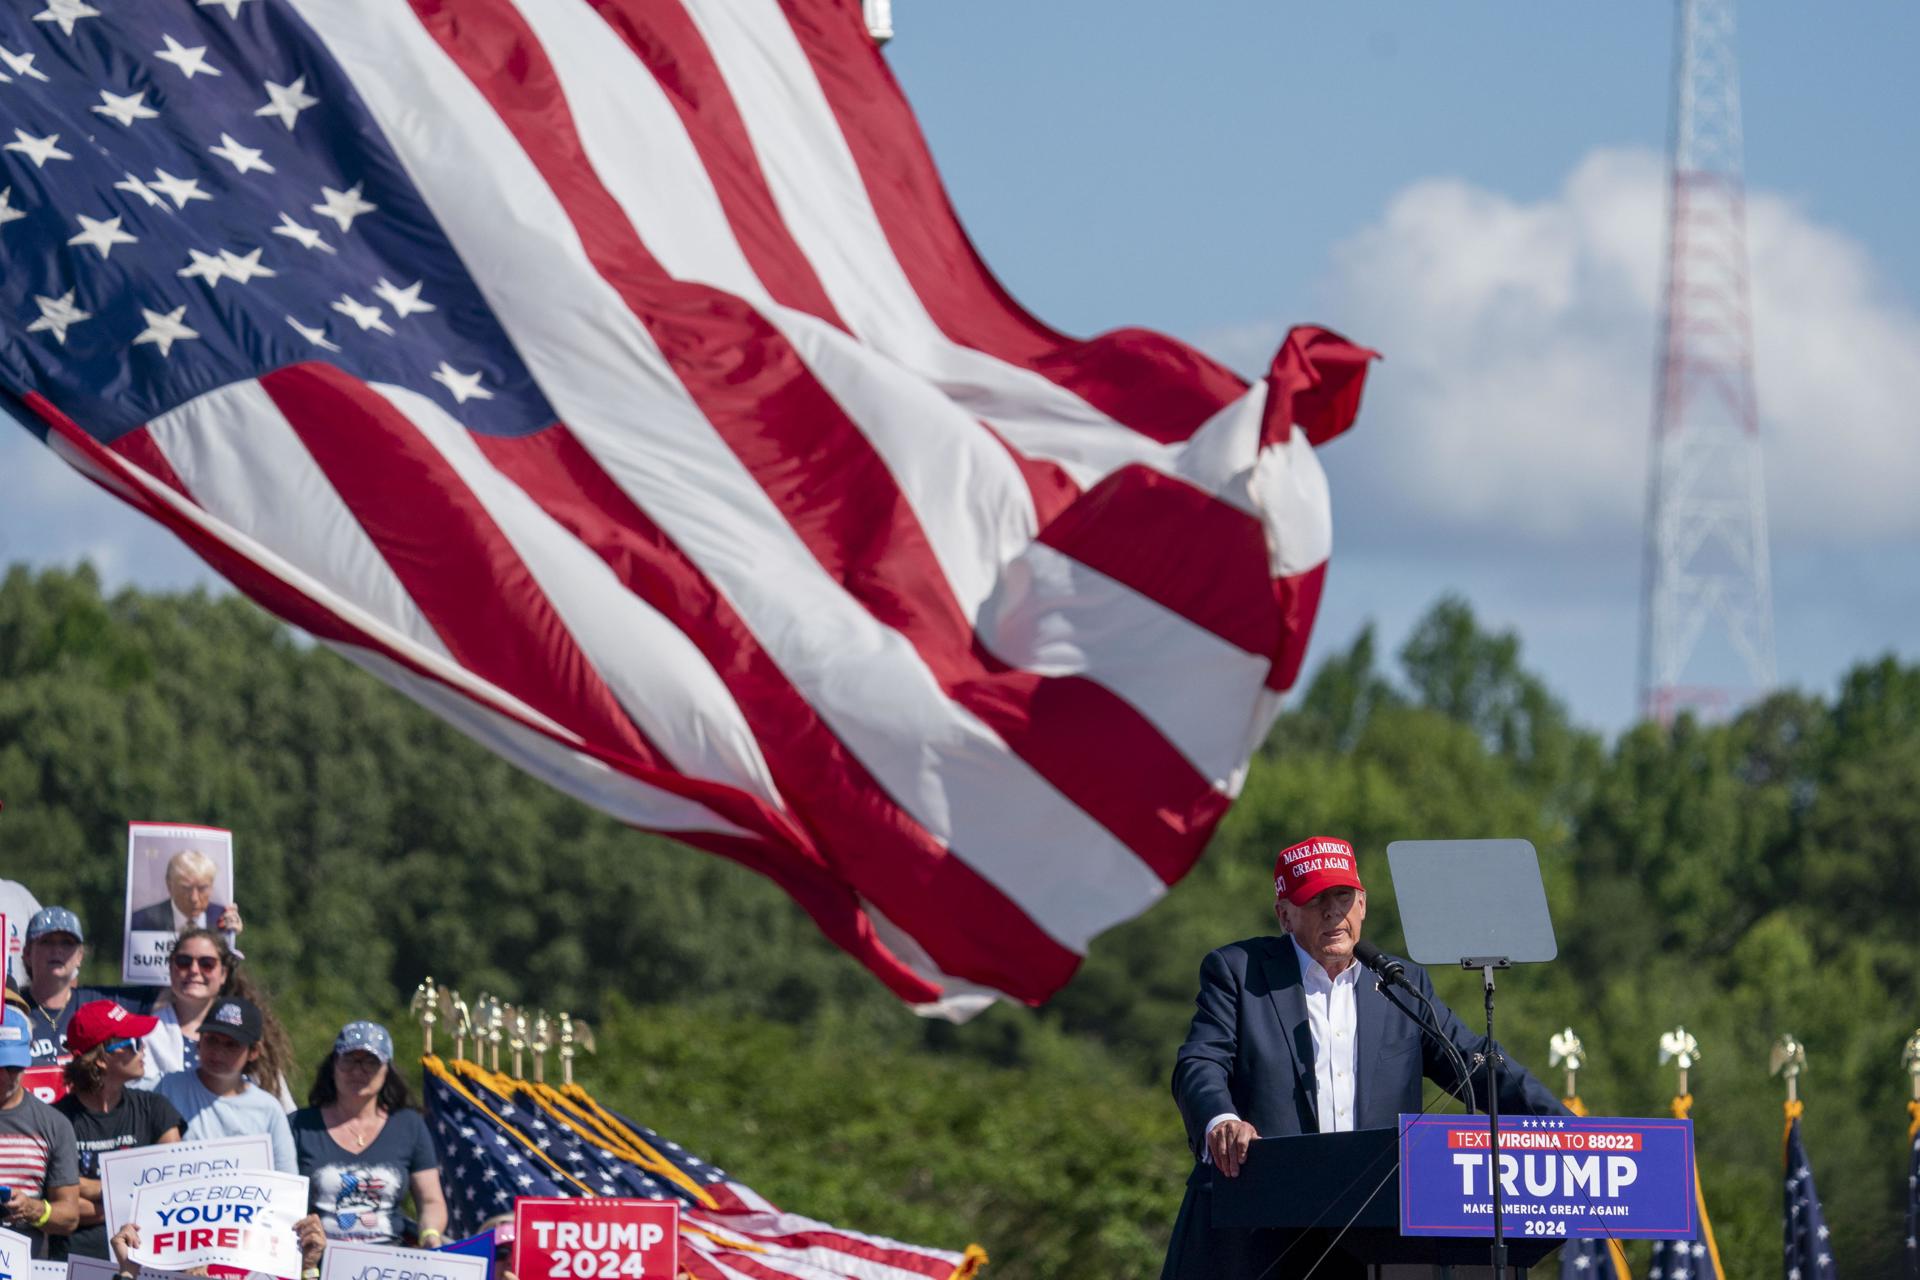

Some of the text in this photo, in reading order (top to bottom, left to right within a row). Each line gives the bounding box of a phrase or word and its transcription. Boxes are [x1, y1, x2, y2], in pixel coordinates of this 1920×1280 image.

[1283, 842, 1352, 864] MAKE AMERICA
[1292, 857, 1349, 878] GREAT AGAIN
[1456, 1132, 1634, 1149] TEXT VIRGINIA TO 88022
[1453, 1153, 1638, 1198] TRUMP
[161, 1185, 272, 1206] JOE BIDEN,
[156, 1204, 265, 1227] YOU'R
[1463, 1203, 1494, 1214] MAKE
[1550, 1205, 1586, 1216] GREAT
[1589, 1205, 1629, 1217] AGAIN!
[531, 1221, 664, 1251] TRUMP
[1524, 1220, 1567, 1236] 2024
[548, 1250, 645, 1280] 2024
